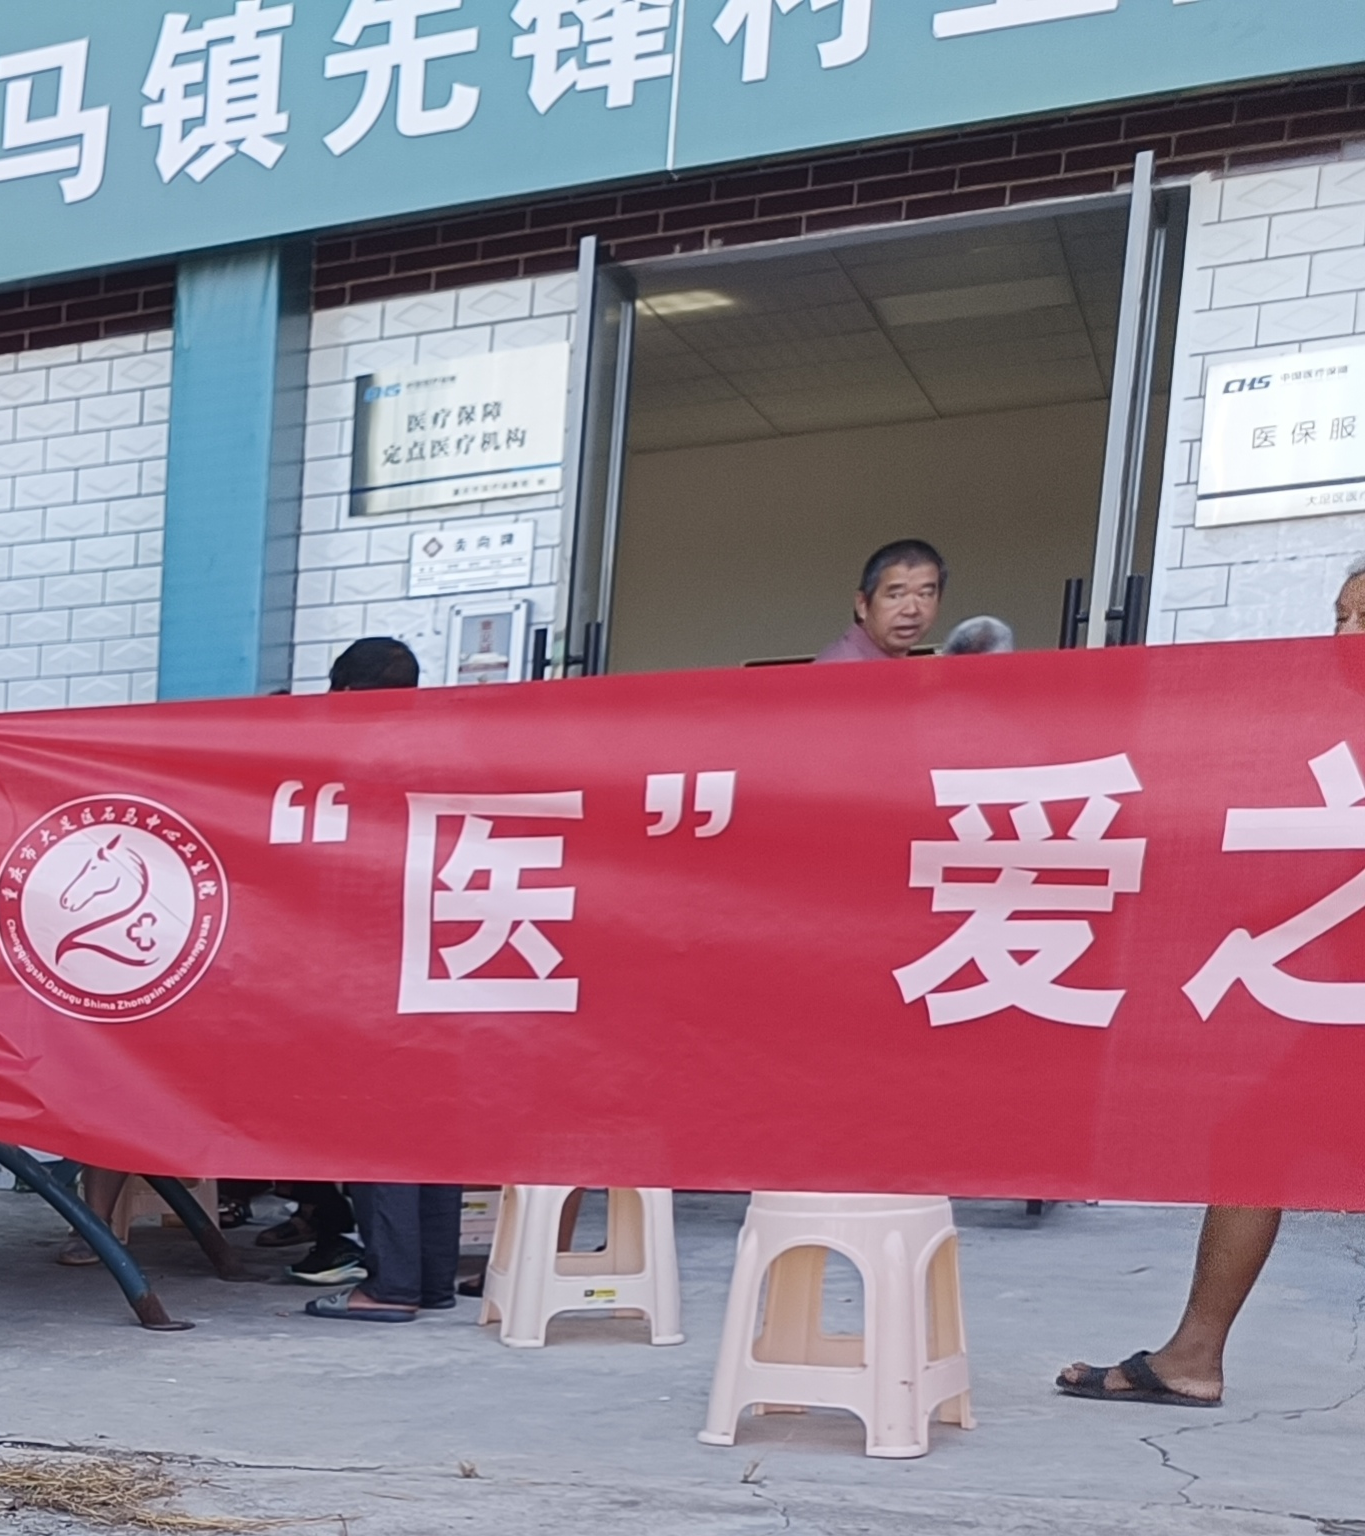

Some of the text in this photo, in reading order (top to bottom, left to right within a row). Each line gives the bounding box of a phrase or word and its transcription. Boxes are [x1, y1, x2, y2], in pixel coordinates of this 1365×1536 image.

[1222, 374, 1273, 394] CHS
[406, 401, 503, 433] 医疗保障
[1251, 415, 1358, 450] 医保服
[381, 427, 527, 467] 定点医疗机构
[6, 914, 212, 1011] Chongqingshi Dazuqu Shima Zhongxin Weishengyuan
